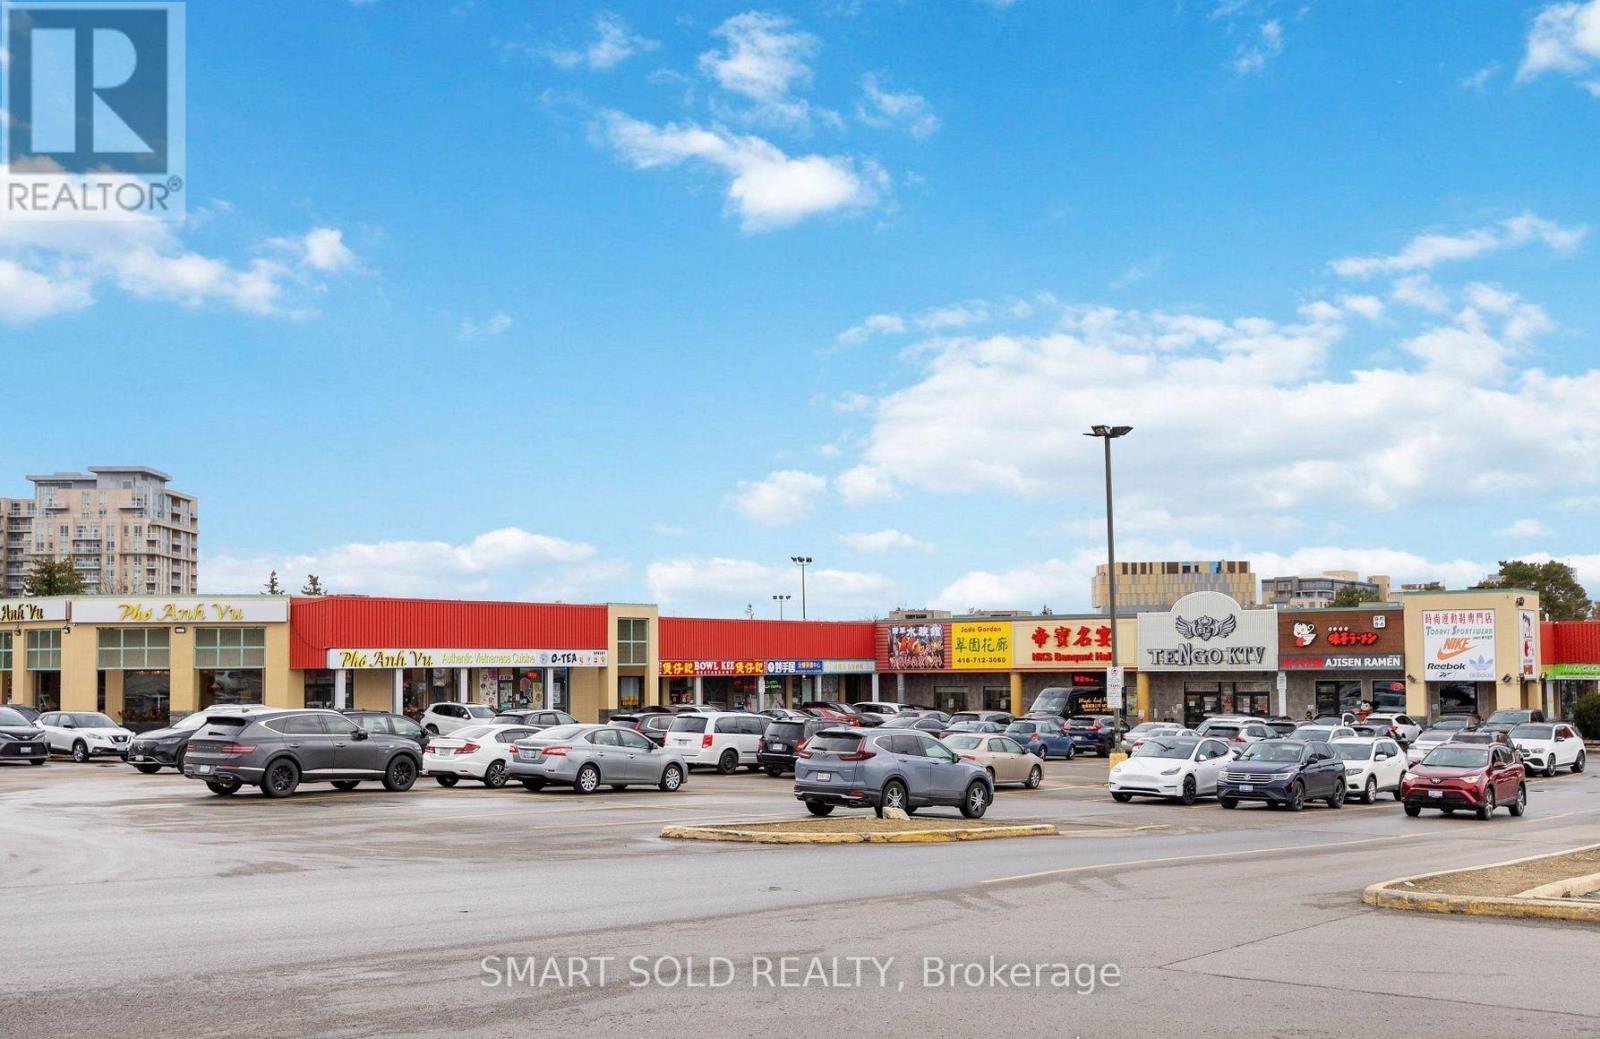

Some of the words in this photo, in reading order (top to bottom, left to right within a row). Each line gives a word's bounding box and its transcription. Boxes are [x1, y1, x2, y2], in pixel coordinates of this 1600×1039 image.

[157, 602, 206, 621] Anh
[1443, 637, 1473, 650] NIKE
[369, 650, 407, 668] Anh
[442, 652, 473, 664] Authentic
[475, 652, 512, 664] Vietnamese
[512, 652, 536, 664] Cuisine
[551, 653, 577, 664] O-TEA
[1226, 646, 1266, 665] KTV
[694, 661, 719, 671] BOWL
[1325, 657, 1362, 667] AJISEN
[1364, 657, 1401, 667] RAMEN
[1427, 662, 1466, 670] Reebok
